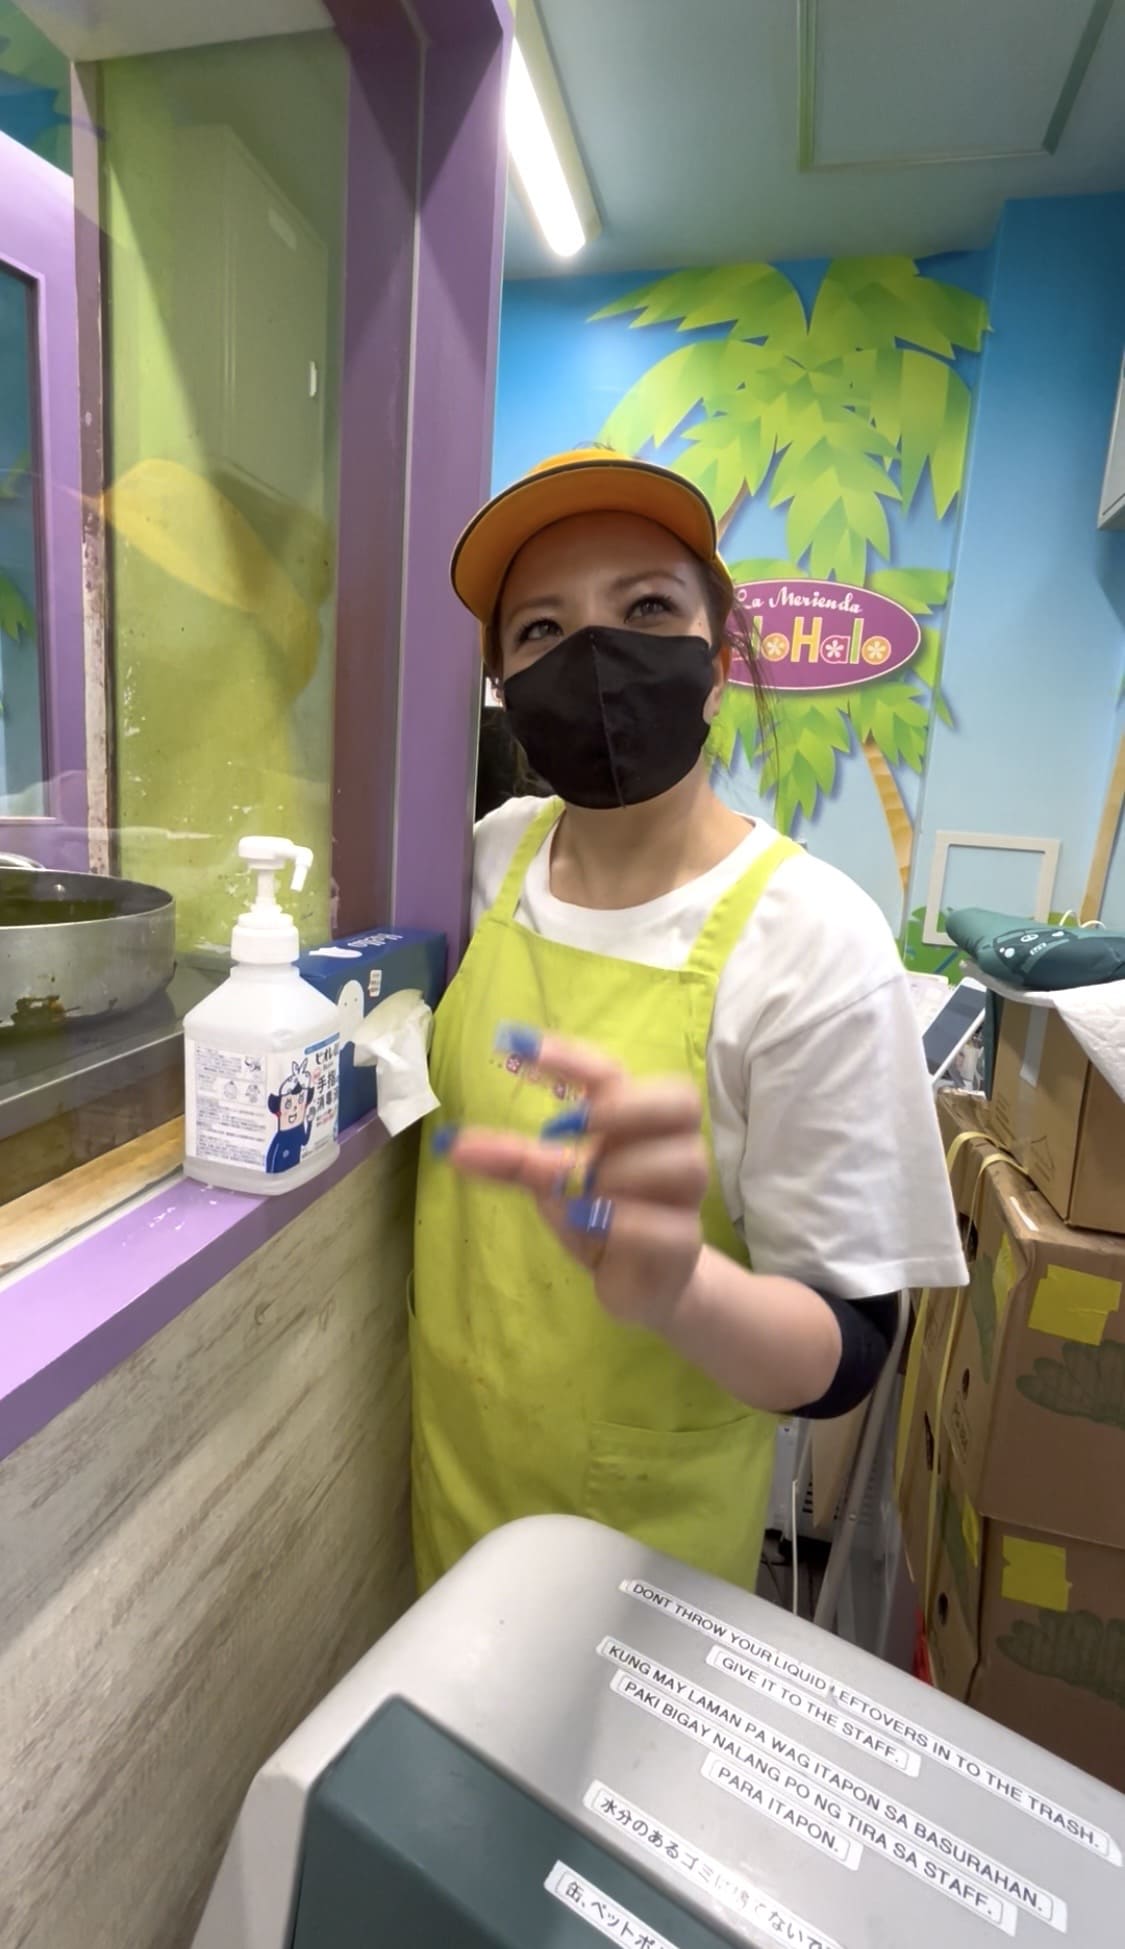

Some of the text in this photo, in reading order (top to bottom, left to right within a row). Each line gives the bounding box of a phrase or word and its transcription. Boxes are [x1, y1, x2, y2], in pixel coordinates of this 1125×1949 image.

[768, 586, 863, 614] Merienda
[633, 1584, 672, 1608] DONT
[675, 1606, 726, 1637] THROW
[729, 1632, 772, 1663] YOUR
[774, 1657, 826, 1690] LIQUID
[932, 1741, 951, 1761] IN
[954, 1754, 981, 1778] TO
[985, 1770, 1023, 1802] THE
[1025, 1793, 1100, 1849] TRASH.
[721, 1656, 900, 1764] GIVE IT TO THE STAFF.
[609, 1646, 1043, 1912] KUNG MAY LAMAN PA WAG ITAPON SA BASURAHAN.
[624, 1680, 994, 1916] PAKI BIGAY NALANG PO NG TIRA SA STAFF.
[717, 1766, 840, 1854] PARA ITAPON.
[565, 1881, 664, 1949] 缶、ペットボ
